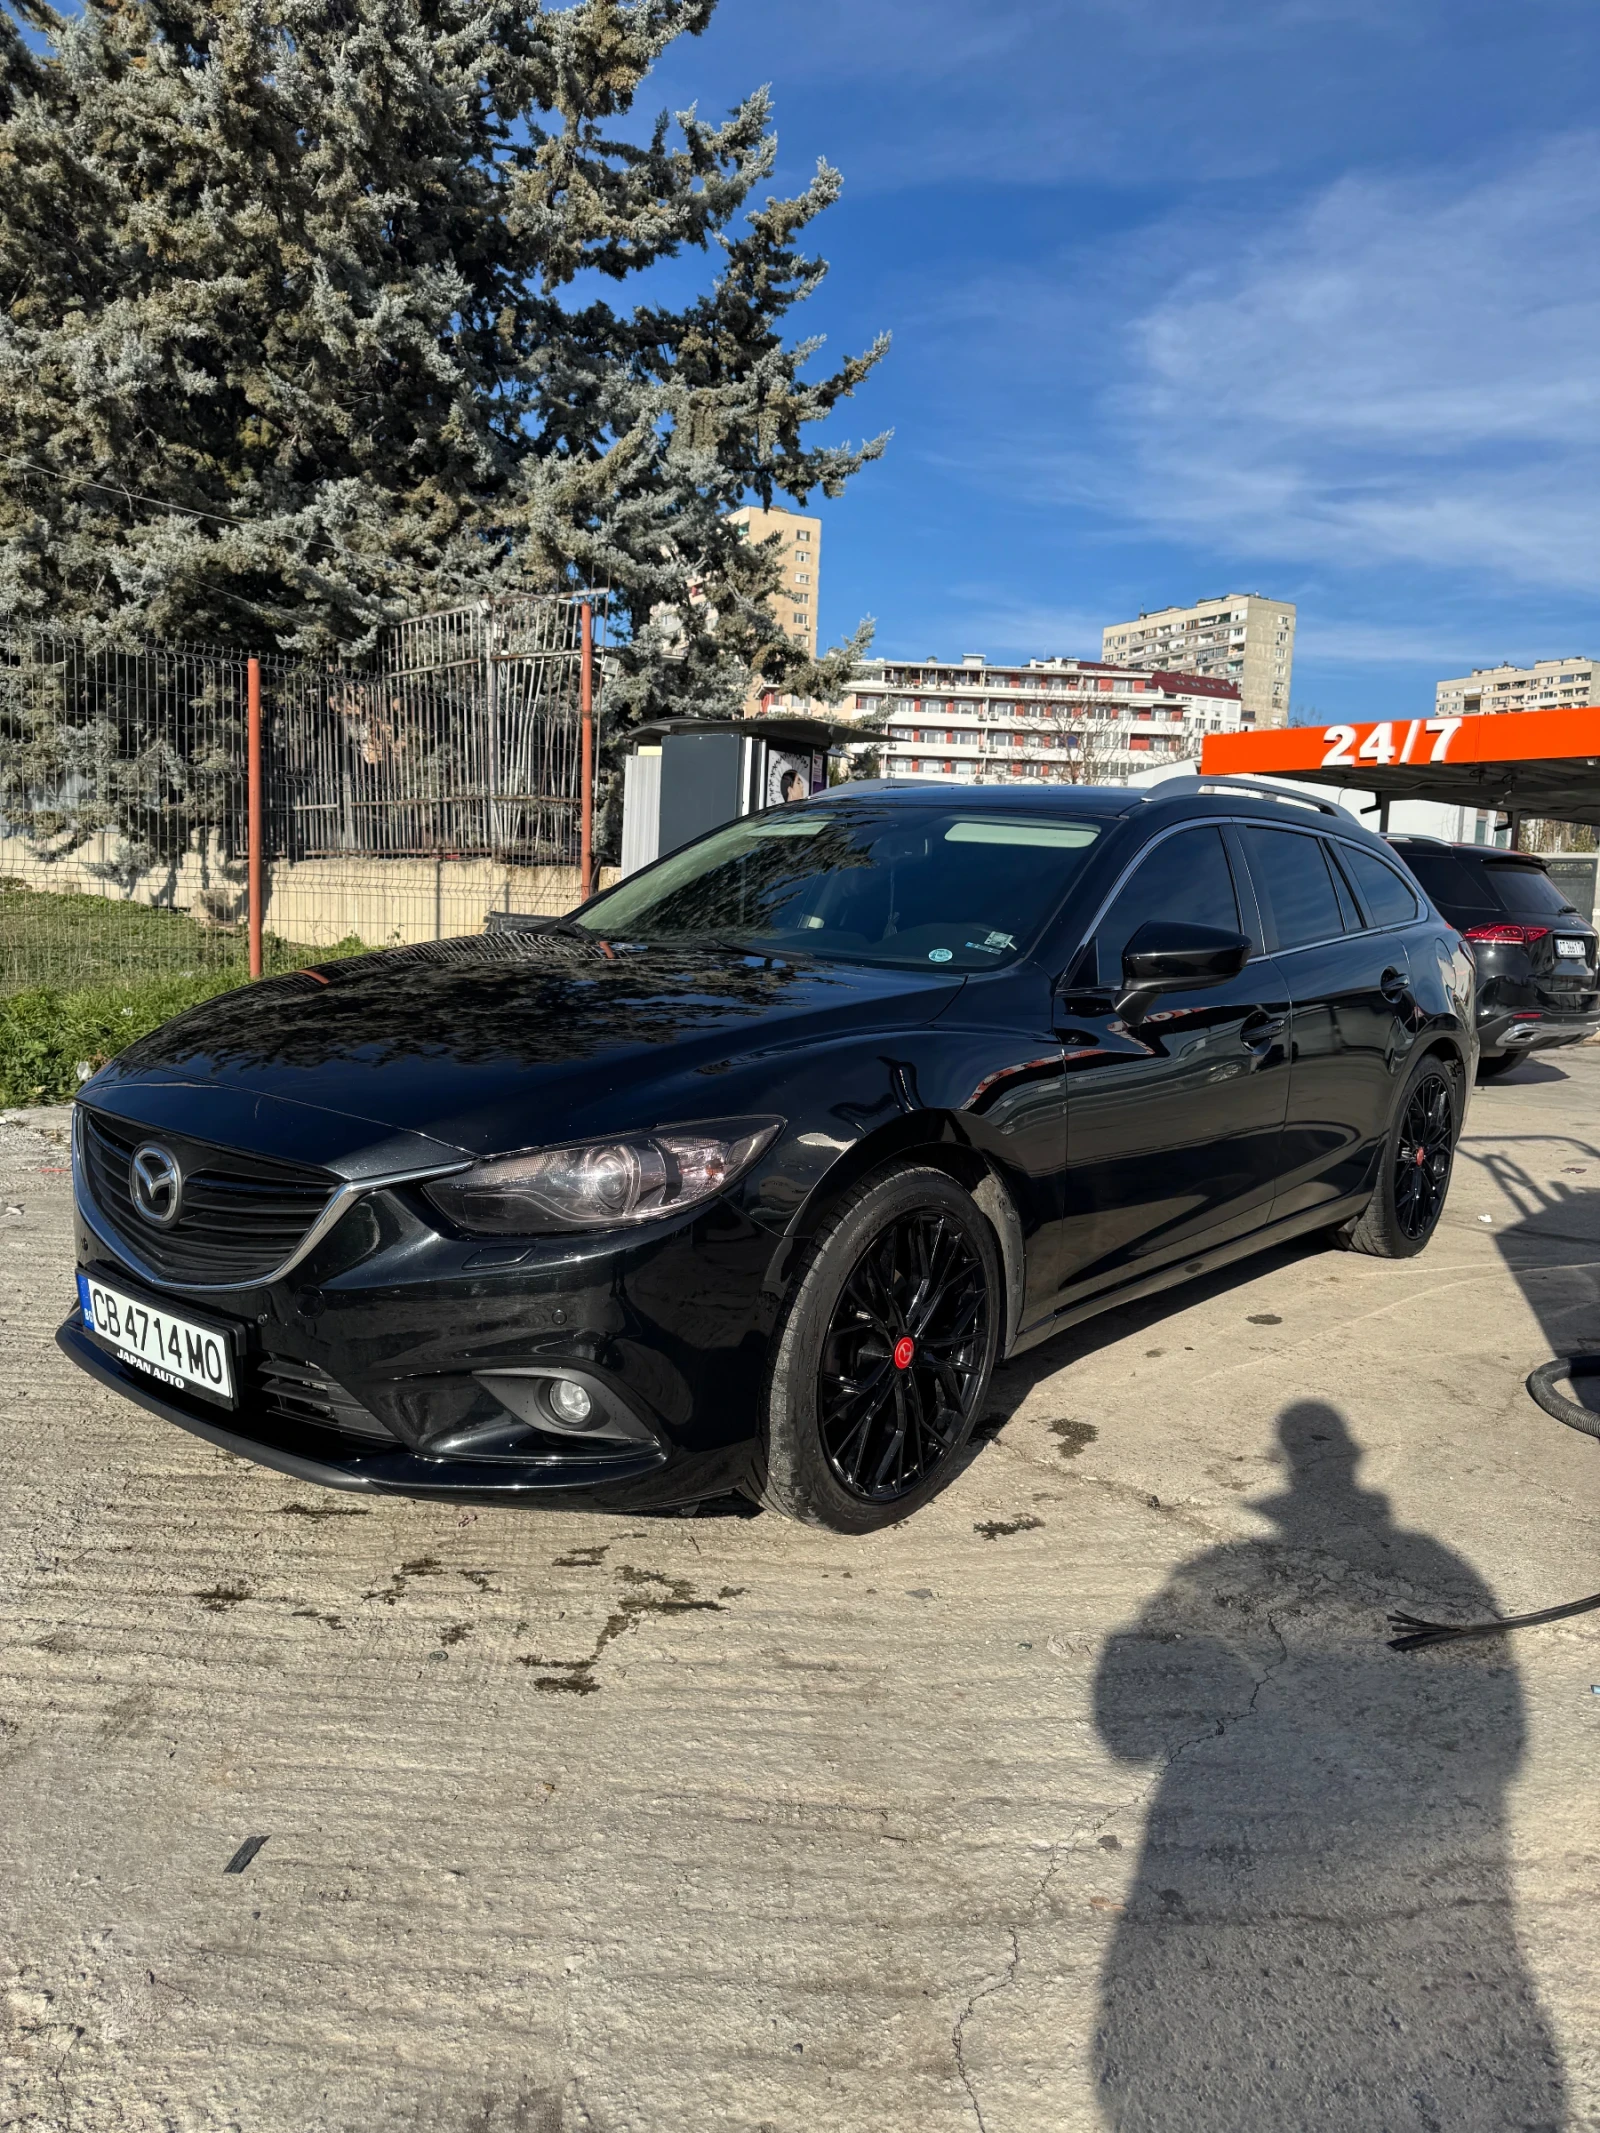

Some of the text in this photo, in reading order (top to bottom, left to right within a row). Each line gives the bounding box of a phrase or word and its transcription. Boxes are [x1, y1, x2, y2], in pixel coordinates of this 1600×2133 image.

[1321, 718, 1462, 766] 24/7
[84, 1308, 93, 1323] BG
[93, 1288, 222, 1384] CB 4714 MO
[117, 1349, 185, 1389] JAPAN AUTO
